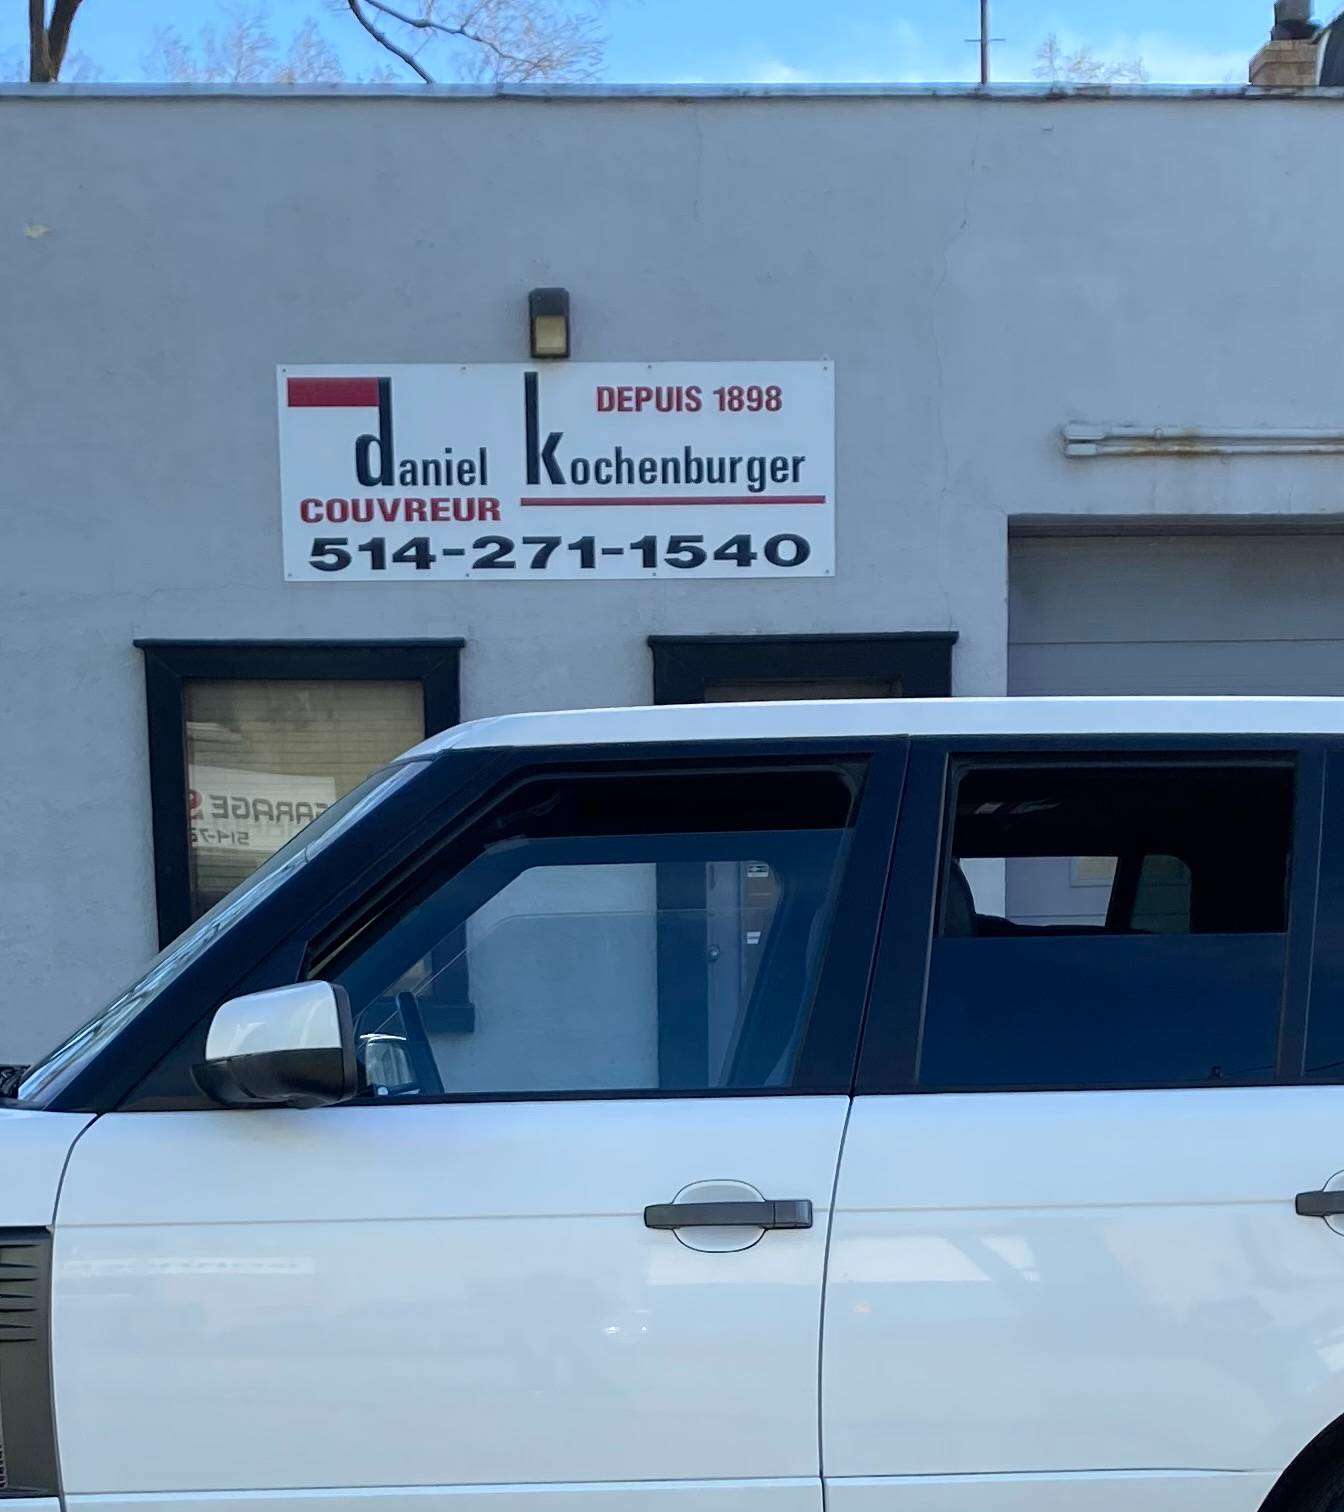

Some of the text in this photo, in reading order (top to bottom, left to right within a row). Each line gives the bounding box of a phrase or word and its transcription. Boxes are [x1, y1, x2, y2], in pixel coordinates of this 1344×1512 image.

[596, 384, 783, 412] DEPUIS 1898
[299, 497, 501, 523] COUVREUR
[309, 533, 812, 572] 514-271-1540
